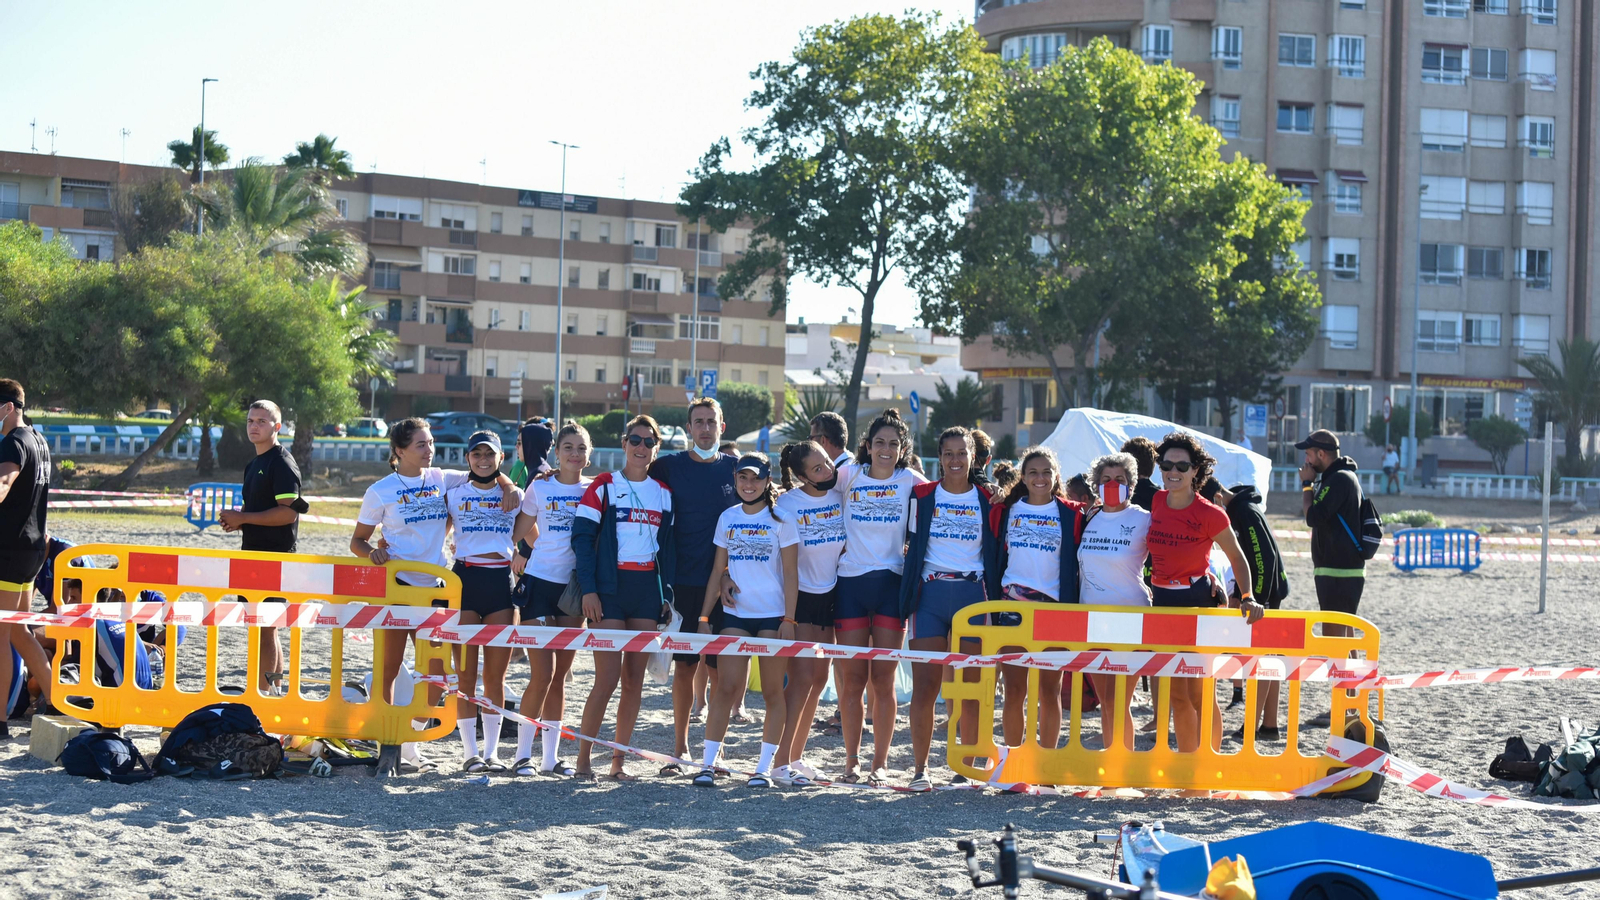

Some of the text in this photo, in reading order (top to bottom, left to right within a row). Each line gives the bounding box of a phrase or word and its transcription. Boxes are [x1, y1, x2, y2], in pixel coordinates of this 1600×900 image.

[1422, 377, 1523, 389] Restaurante Chino
[850, 484, 899, 492] CAMPEONATO
[867, 489, 897, 498] ESPAÑA
[461, 495, 503, 503] CAMPEONA
[797, 503, 840, 515] CAMPEONATO
[935, 502, 980, 511] AMPEONATO
[404, 516, 427, 525] REMO
[851, 513, 872, 522] REMO
[884, 515, 901, 523] MAR
[495, 526, 510, 534] MAR
[728, 522, 772, 531] CAMPEONATO
[804, 538, 826, 547] REMO
[837, 534, 847, 543] MA
[960, 533, 978, 541] MAR
[1089, 536, 1110, 544] ESPAÑA
[1248, 526, 1261, 552] BLANCA
[1040, 544, 1057, 553] MAR
[1255, 552, 1265, 574] COSTA
[163, 606, 194, 623] AMETEL
[236, 607, 266, 624] AMETEL
[308, 608, 340, 625] AMETEL
[381, 609, 412, 627] AMETEL
[429, 626, 461, 641] AMETEL
[506, 628, 538, 645] AMETEL
[583, 632, 615, 648] AMETEL
[660, 635, 693, 651] AMETEL
[737, 641, 770, 653] AMETEL
[1097, 655, 1130, 673] AMETEL
[1174, 656, 1206, 675] AMETEL
[1249, 659, 1281, 678] AMETEL
[1326, 662, 1357, 679] AMETEL
[1447, 669, 1478, 682] AMETEL
